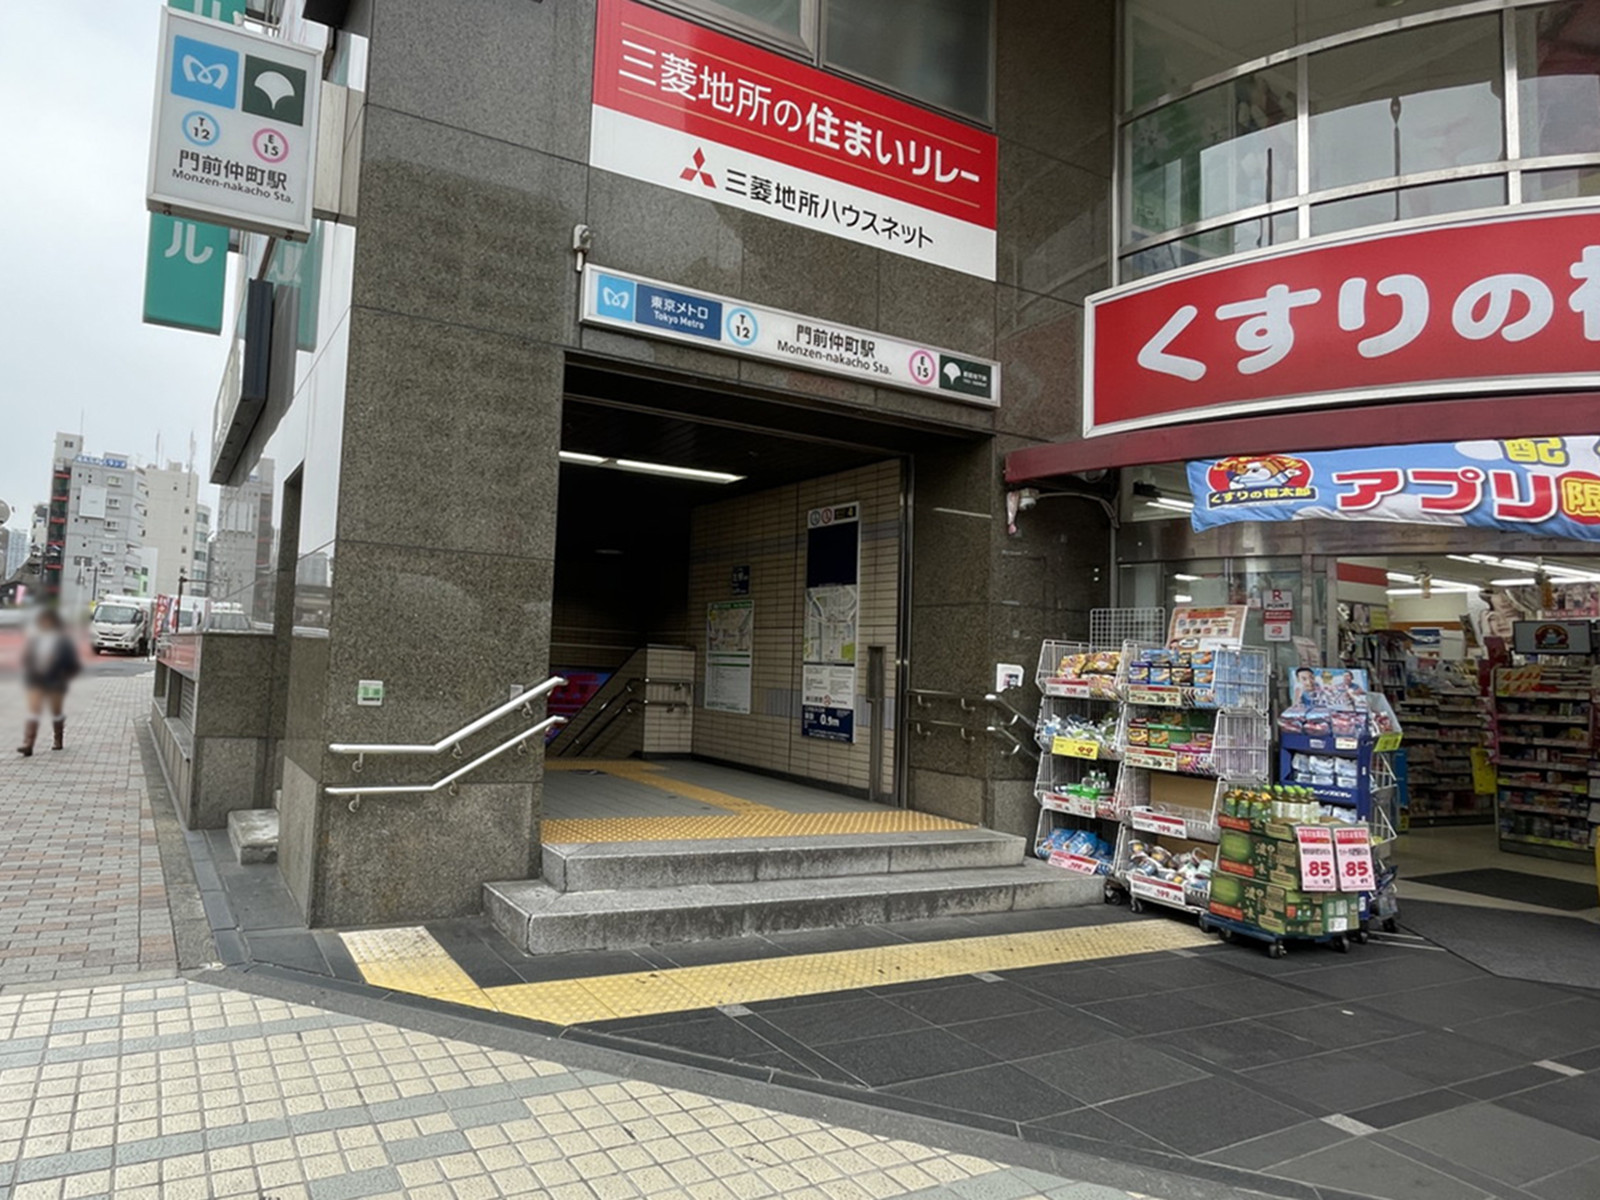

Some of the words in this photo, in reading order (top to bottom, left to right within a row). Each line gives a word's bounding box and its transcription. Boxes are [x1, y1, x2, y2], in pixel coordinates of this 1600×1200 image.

[618, 39, 981, 185] 三菱地所の住まいリレー
[198, 117, 205, 127] T
[193, 128, 210, 140] 12
[268, 134, 275, 144] E
[263, 144, 279, 157] 15
[178, 149, 288, 191] 門前仲町駅
[171, 168, 271, 199] Monzen-nakacho
[273, 191, 295, 205] Sta.
[725, 168, 933, 249] 三菱地所ハウスネット
[651, 295, 709, 320] 東京メトロ
[653, 310, 678, 325] Tokyo
[680, 316, 705, 331] Metro
[739, 314, 746, 325] T
[735, 325, 751, 339] 12
[796, 324, 876, 358] 門前仲町駅
[777, 340, 870, 371] Monzen-nakacho
[873, 362, 892, 376] Sta.
[917, 366, 929, 378] 15
[1210, 487, 1312, 504] くすりの福太郎
[1272, 589, 1283, 601] R
[1309, 861, 1331, 877] 85
[1345, 861, 1369, 877] 85
